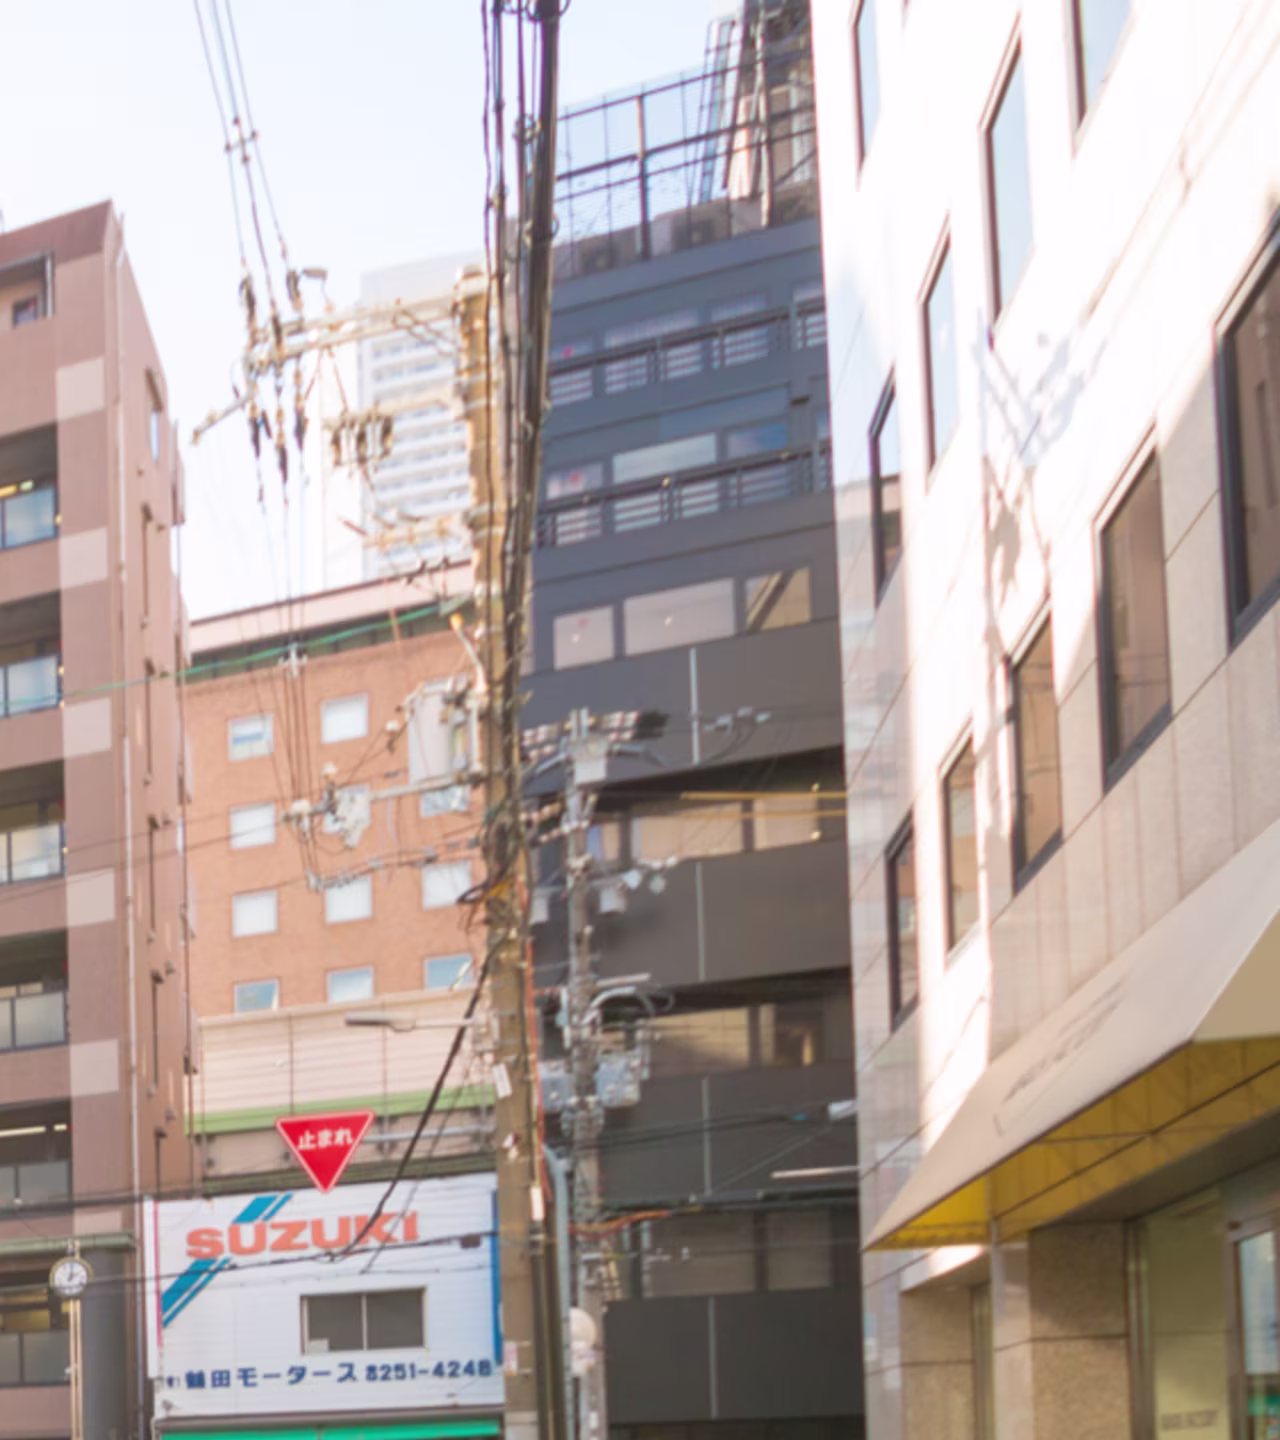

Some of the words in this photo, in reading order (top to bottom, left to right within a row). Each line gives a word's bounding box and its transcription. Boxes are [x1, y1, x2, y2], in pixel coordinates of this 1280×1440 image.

[297, 1127, 353, 1151] 止まれ
[185, 1210, 419, 1260] SUZUKI
